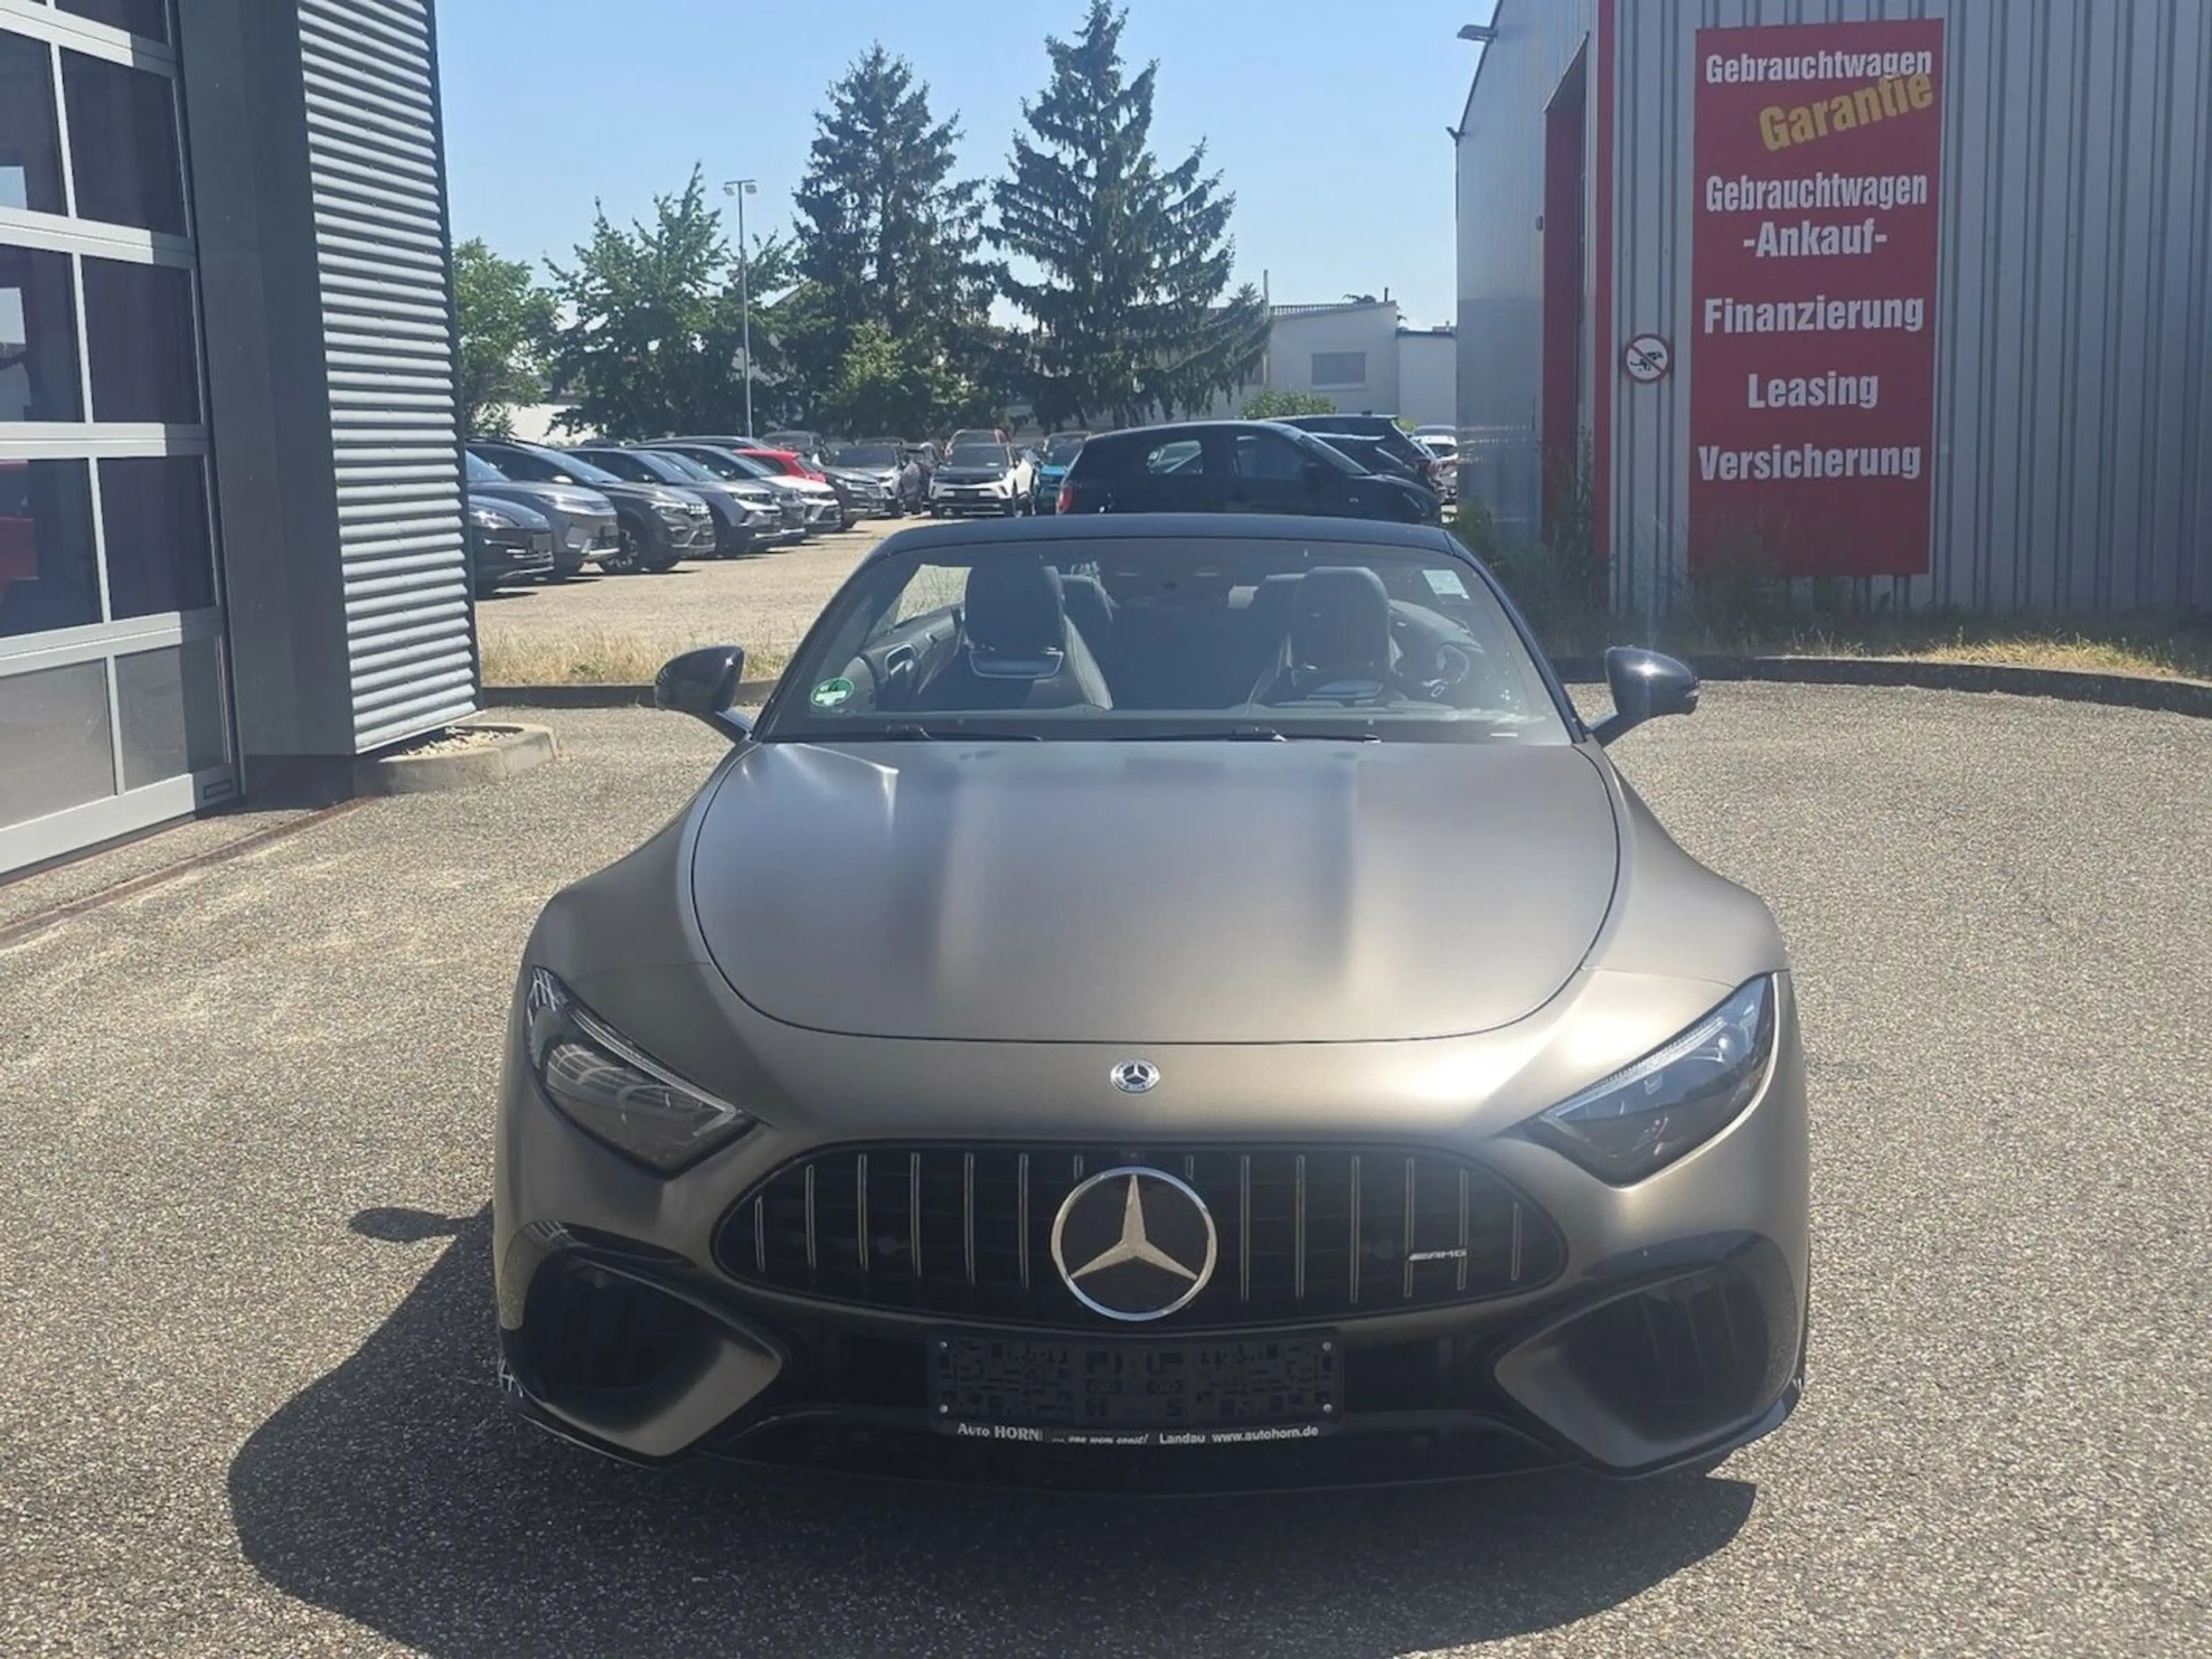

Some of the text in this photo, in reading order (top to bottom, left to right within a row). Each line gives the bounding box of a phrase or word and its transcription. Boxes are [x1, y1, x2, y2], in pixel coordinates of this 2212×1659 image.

[1706, 51, 1931, 83] Gebrauchtwagen
[1759, 72, 1933, 151] Garantie
[1706, 172, 1927, 211] Gebrauchtwagen
[1744, 218, 1887, 257] -Ankauf-
[1705, 294, 1924, 334] Finanzierung
[1748, 370, 1878, 408] Leasing
[1698, 444, 1921, 480] Versicherung
[994, 1425, 1043, 1441] HORN
[1159, 1432, 1205, 1444] Landau
[1211, 1425, 1319, 1444] www.autohorn.de
